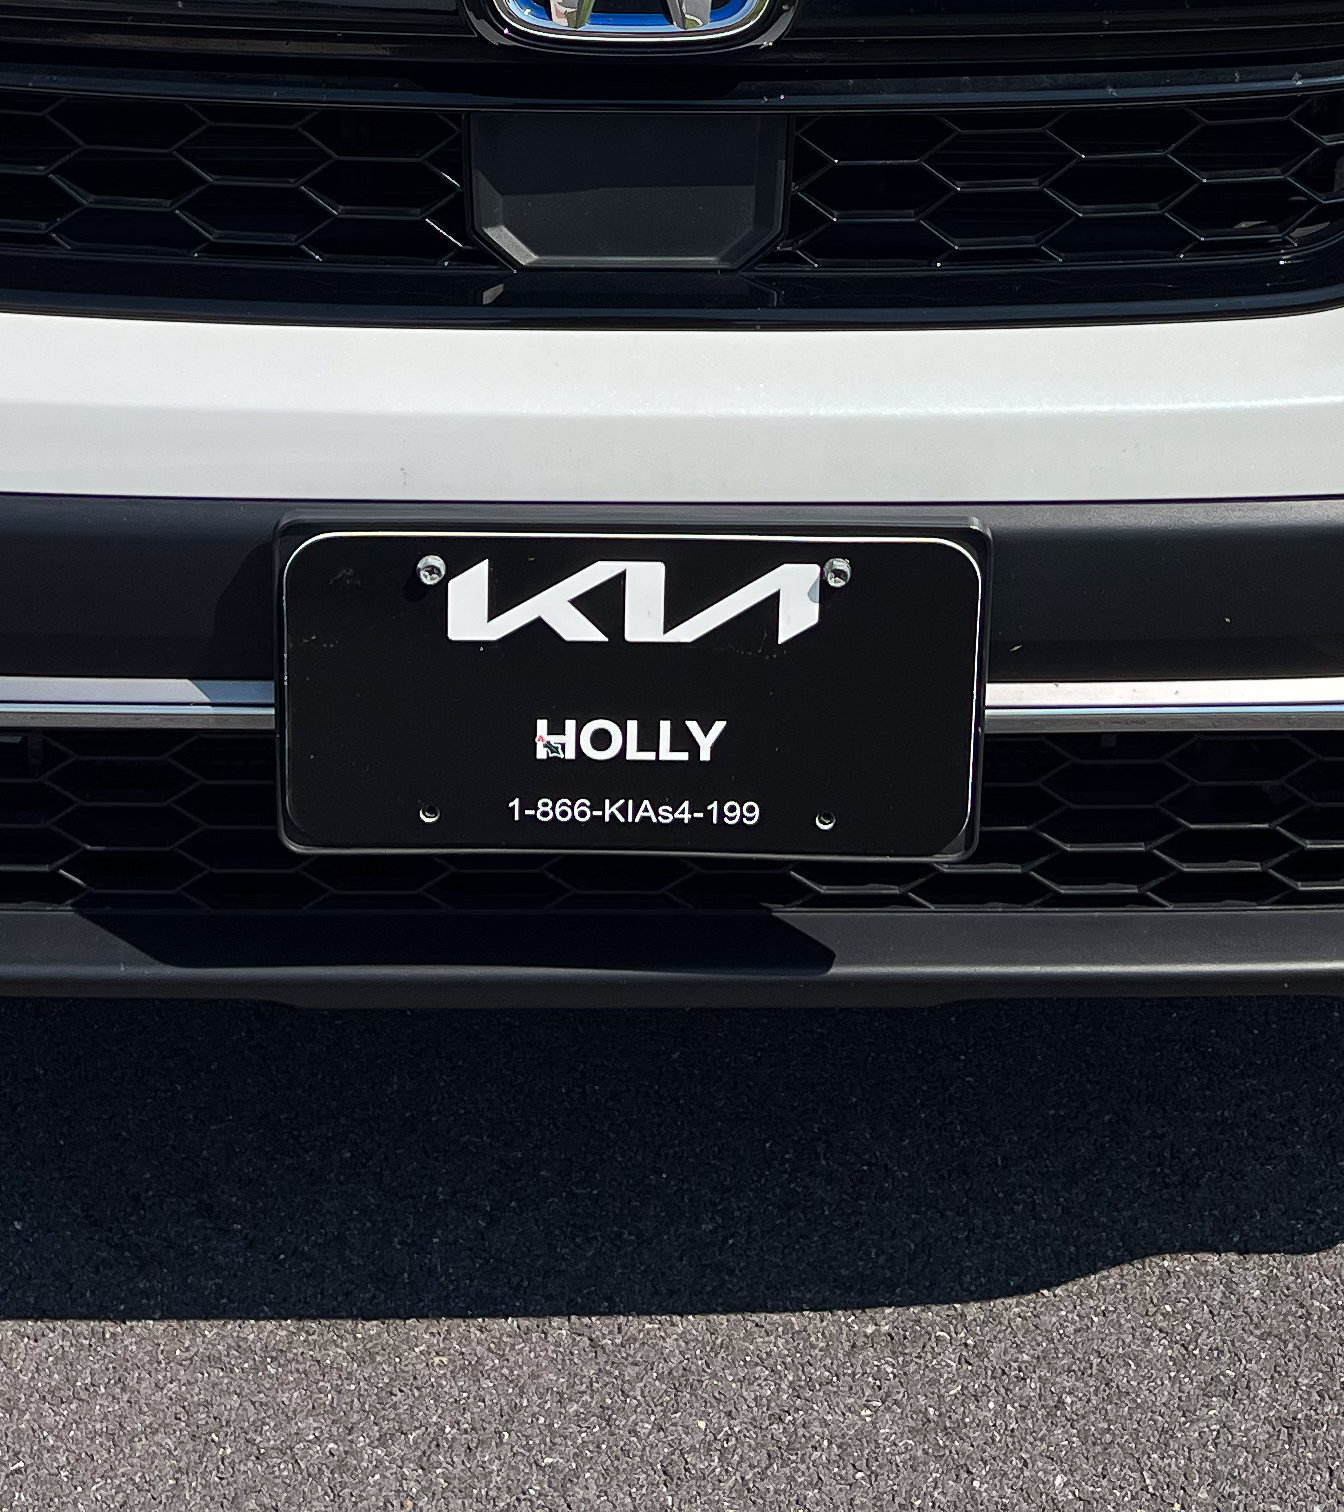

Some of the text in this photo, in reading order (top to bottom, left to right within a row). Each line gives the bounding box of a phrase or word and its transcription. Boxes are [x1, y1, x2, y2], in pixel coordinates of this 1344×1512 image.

[447, 559, 821, 645] KIA
[535, 718, 727, 762] HOLLY
[507, 798, 761, 826] 1-866-KIAs4-199
